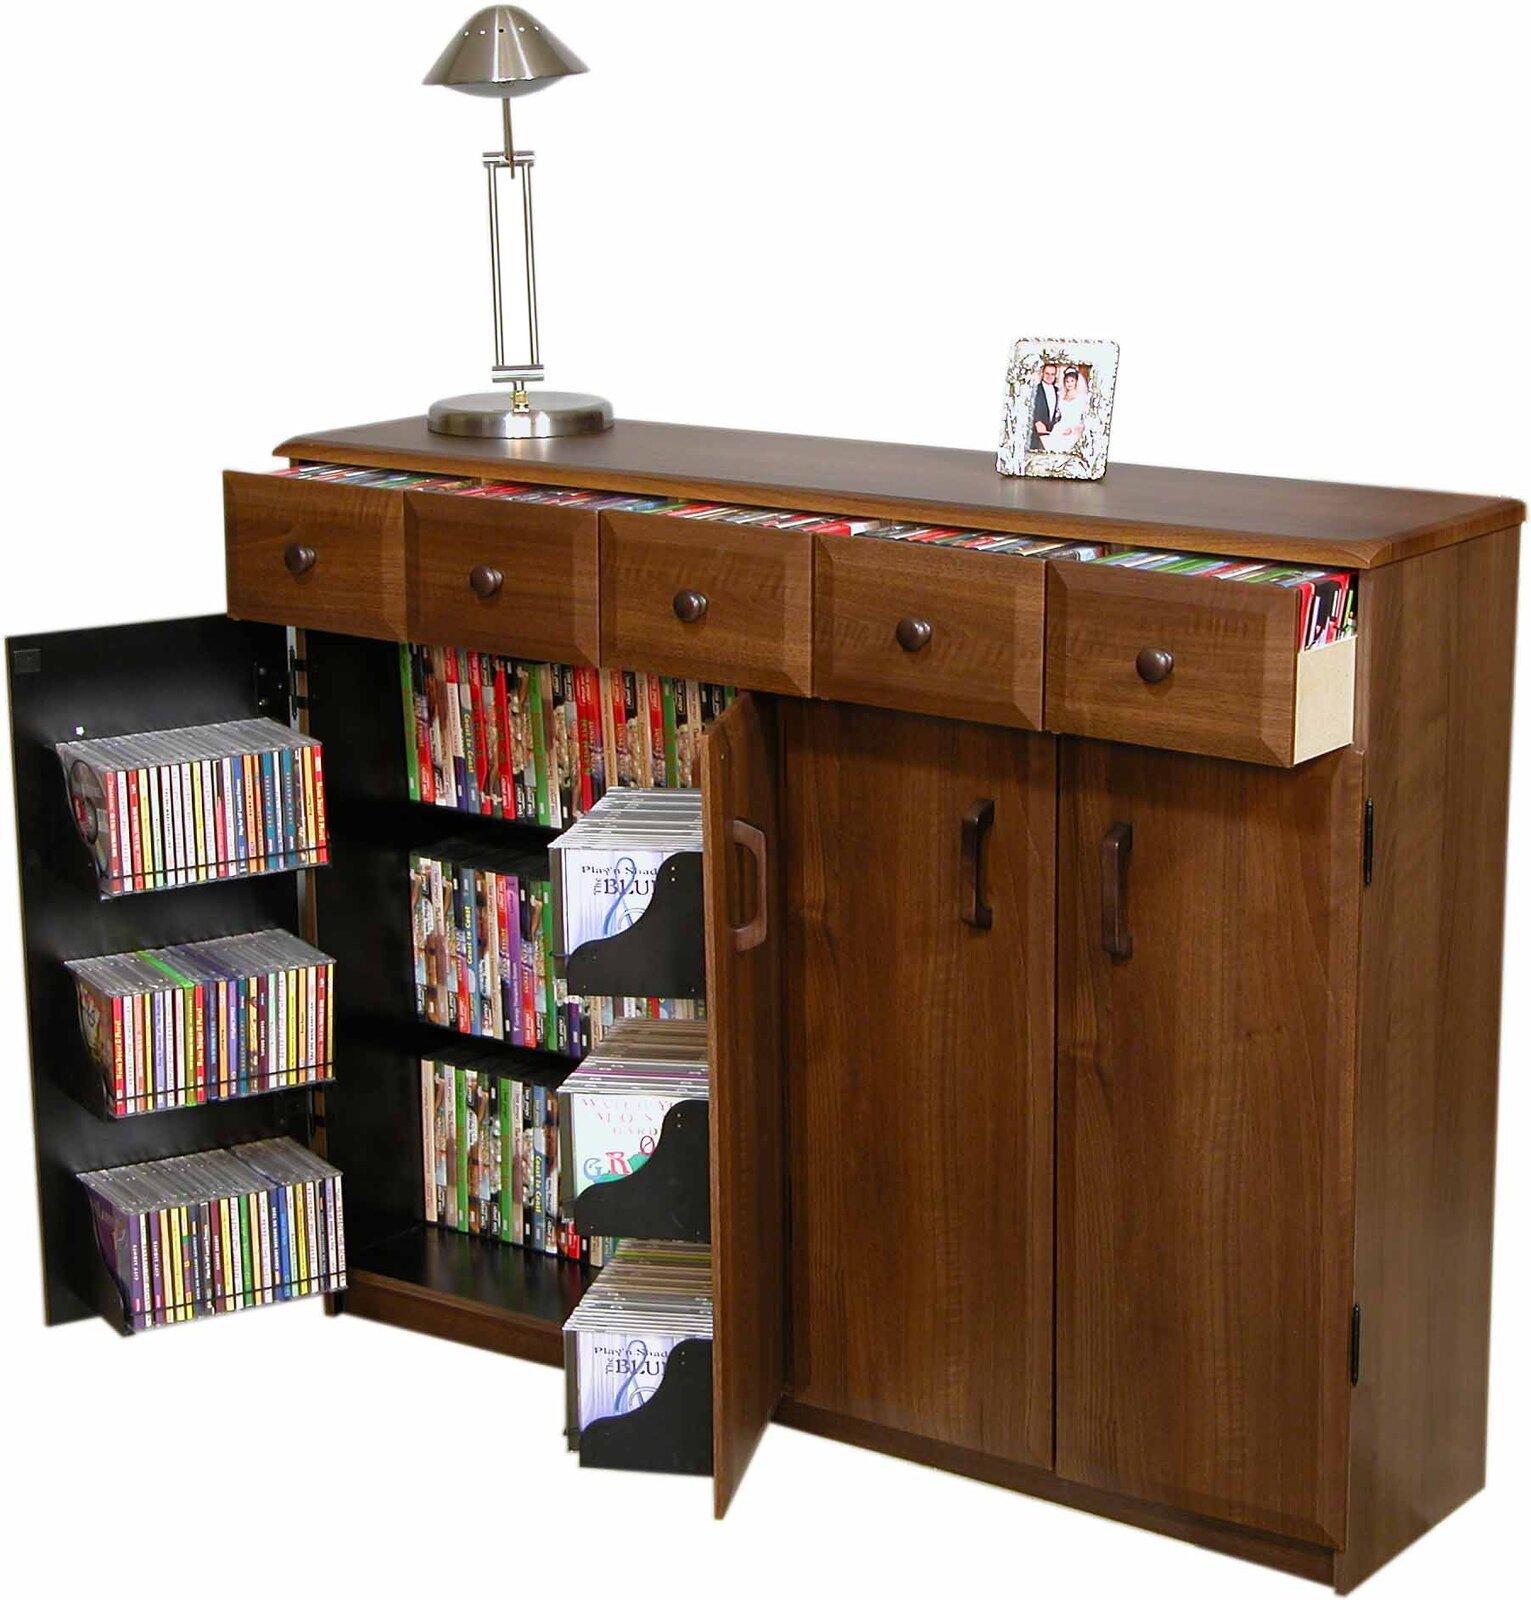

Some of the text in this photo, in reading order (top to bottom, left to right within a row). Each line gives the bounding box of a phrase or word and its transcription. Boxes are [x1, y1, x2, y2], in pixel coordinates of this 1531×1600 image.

[593, 877, 601, 895] The
[604, 878, 657, 896] BLU
[616, 1358, 667, 1376] BLU
